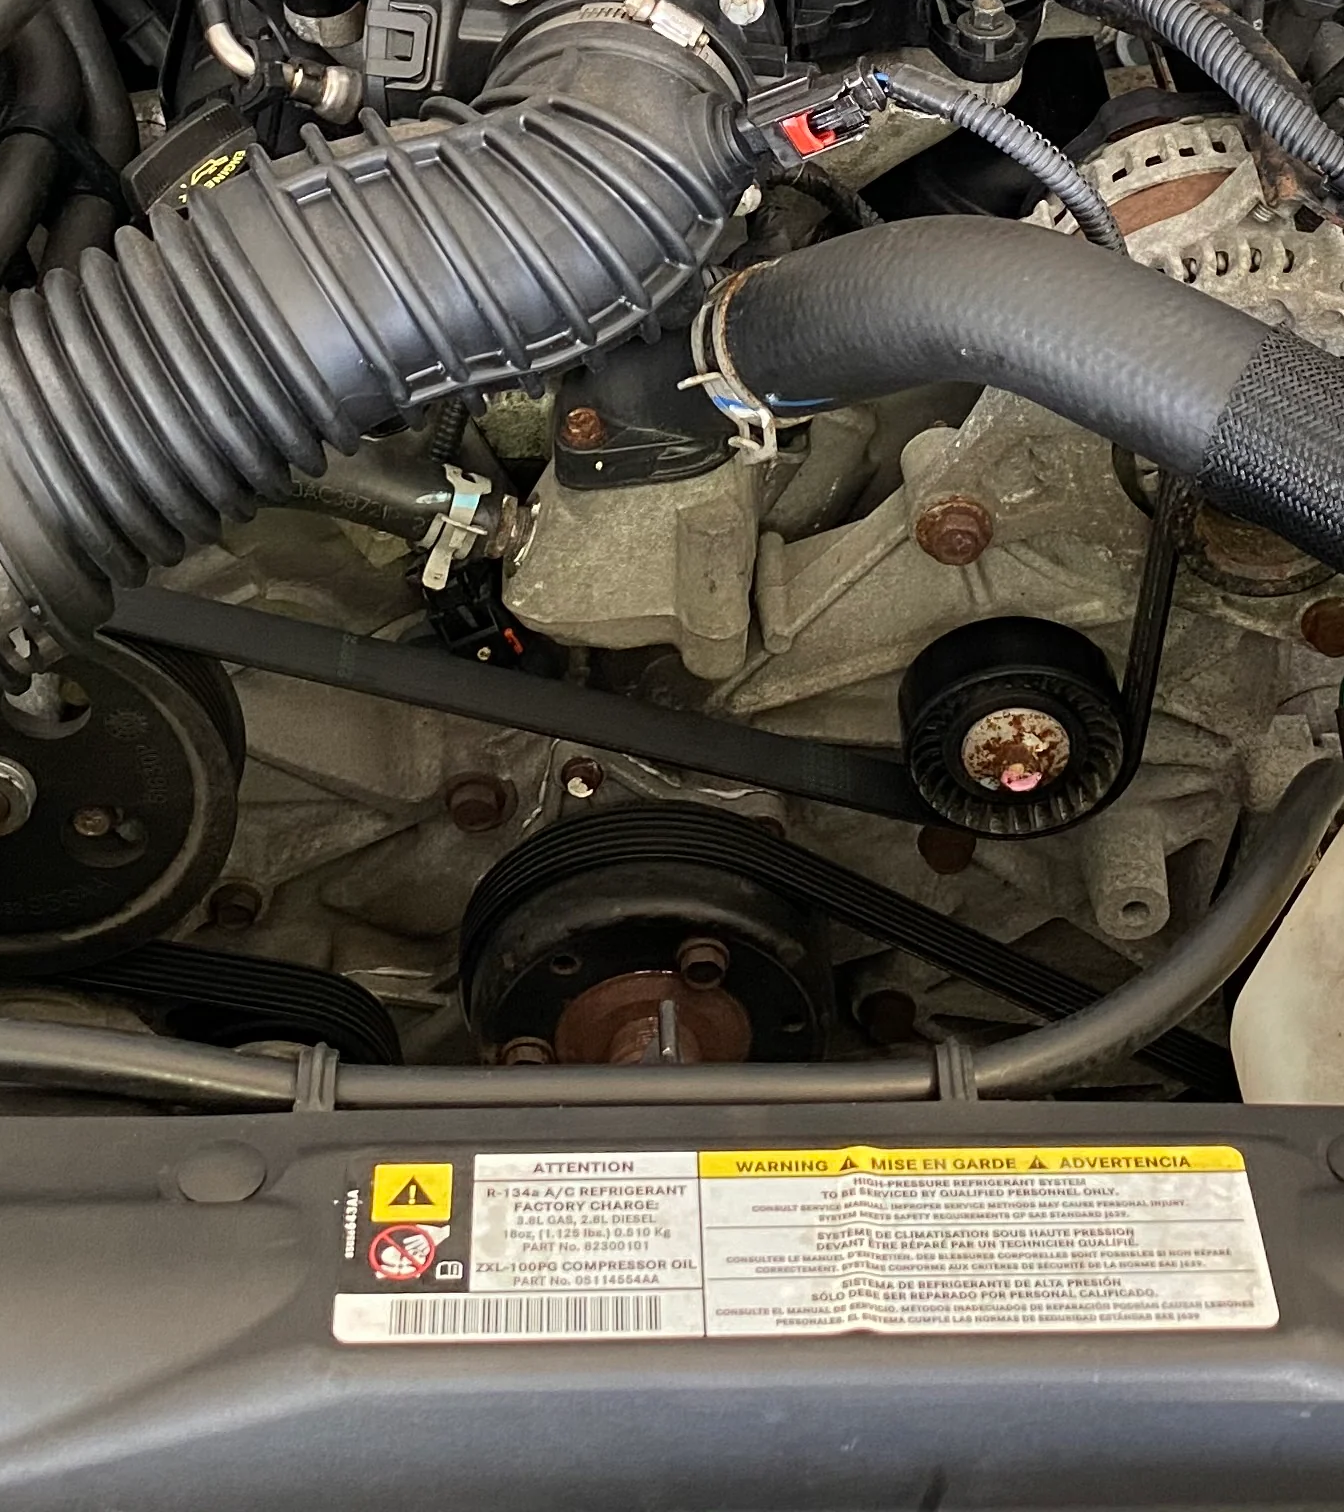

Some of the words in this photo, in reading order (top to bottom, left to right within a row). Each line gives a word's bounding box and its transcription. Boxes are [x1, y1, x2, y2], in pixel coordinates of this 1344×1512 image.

[533, 1161, 634, 1173] ATTENTION
[736, 1160, 829, 1172] WARNING
[871, 1159, 916, 1170] MISE
[922, 1158, 946, 1170] EN
[952, 1157, 1017, 1169] GARDE
[1060, 1156, 1191, 1168] ADVERTENCIA
[855, 1177, 949, 1188] HIGH-PRESSURE
[953, 1178, 1035, 1188] REFRIGERANT
[1038, 1177, 1087, 1186] SYSTEM
[486, 1186, 540, 1198] R-134a
[544, 1186, 574, 1197] A/C
[579, 1185, 688, 1197] REFRIGERANT
[822, 1190, 837, 1200] TO
[841, 1188, 856, 1197] BE
[859, 1187, 917, 1198] SERVICED
[921, 1189, 936, 1198] BY
[939, 1188, 1004, 1198] QUALIFIED
[1007, 1187, 1079, 1197] PERSONNEL
[1083, 1187, 1119, 1196] ONLY.
[514, 1200, 584, 1212] FACTORY
[611, 1213, 657, 1224] DIESEL
[875, 1229, 891, 1240] DE
[894, 1229, 989, 1239] CLIMATISATION
[992, 1228, 1026, 1239] SOUS
[1029, 1227, 1070, 1238] HAUTE
[1073, 1226, 1134, 1237] PRESSION
[523, 1241, 554, 1252] PART
[558, 1241, 579, 1251] No.
[816, 1238, 864, 1251] DEVANT
[867, 1238, 897, 1251] ÊTRE
[950, 1239, 974, 1250] PAR
[977, 1239, 996, 1250] UN
[999, 1238, 1074, 1249] TECHNICIEN
[561, 1259, 666, 1271] COMPRESSOR
[671, 1258, 697, 1270] OIL
[512, 1275, 545, 1286] PART
[549, 1275, 570, 1286] No.
[842, 1277, 894, 1290] SISTEMA
[897, 1280, 914, 1290] DE
[917, 1279, 1011, 1290] REFRIGERANTE
[1014, 1278, 1031, 1289] DE
[1034, 1278, 1063, 1288] ALTA
[1066, 1276, 1122, 1288] PRESIÓN
[811, 1290, 844, 1302] SÓLO
[848, 1288, 879, 1299] DEBE
[883, 1291, 906, 1301] SER
[909, 1291, 977, 1301] REPARADO
[980, 1289, 1006, 1300] POR
[1009, 1289, 1075, 1300] PERSONAL
